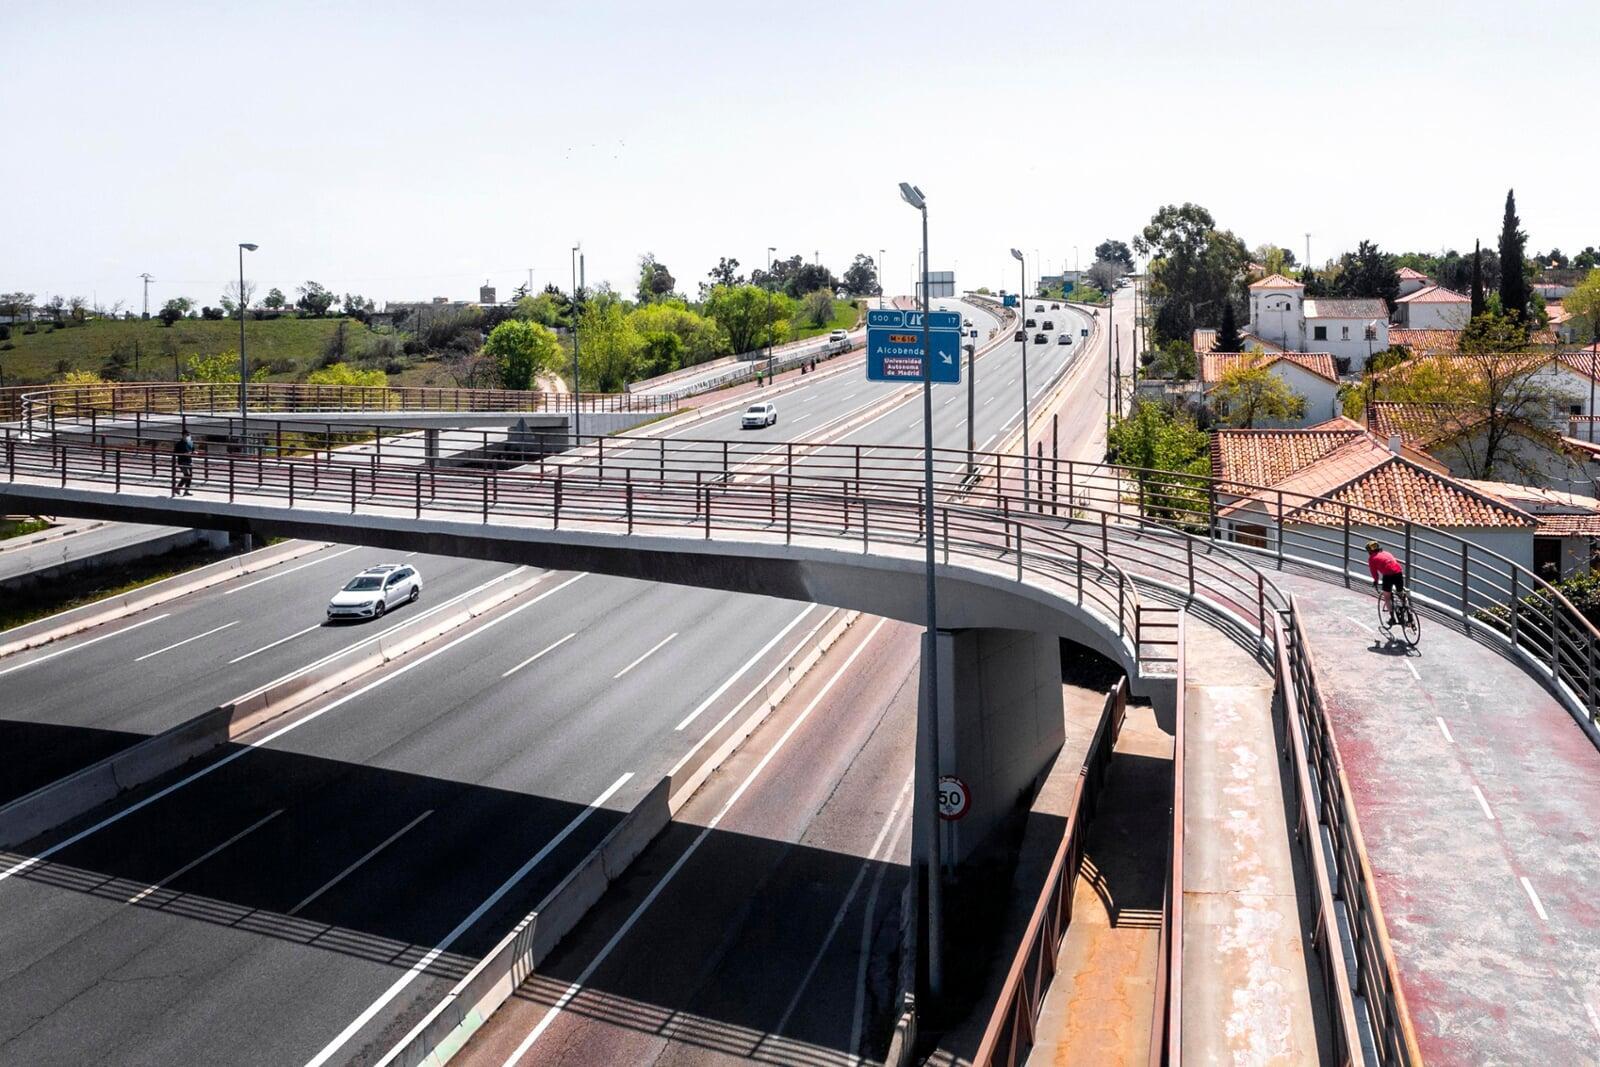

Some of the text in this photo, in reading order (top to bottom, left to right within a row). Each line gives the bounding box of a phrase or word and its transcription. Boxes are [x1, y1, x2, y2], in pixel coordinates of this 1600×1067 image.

[873, 314, 889, 322] 500
[876, 346, 925, 356] Alcobenda
[939, 791, 961, 806] 50
